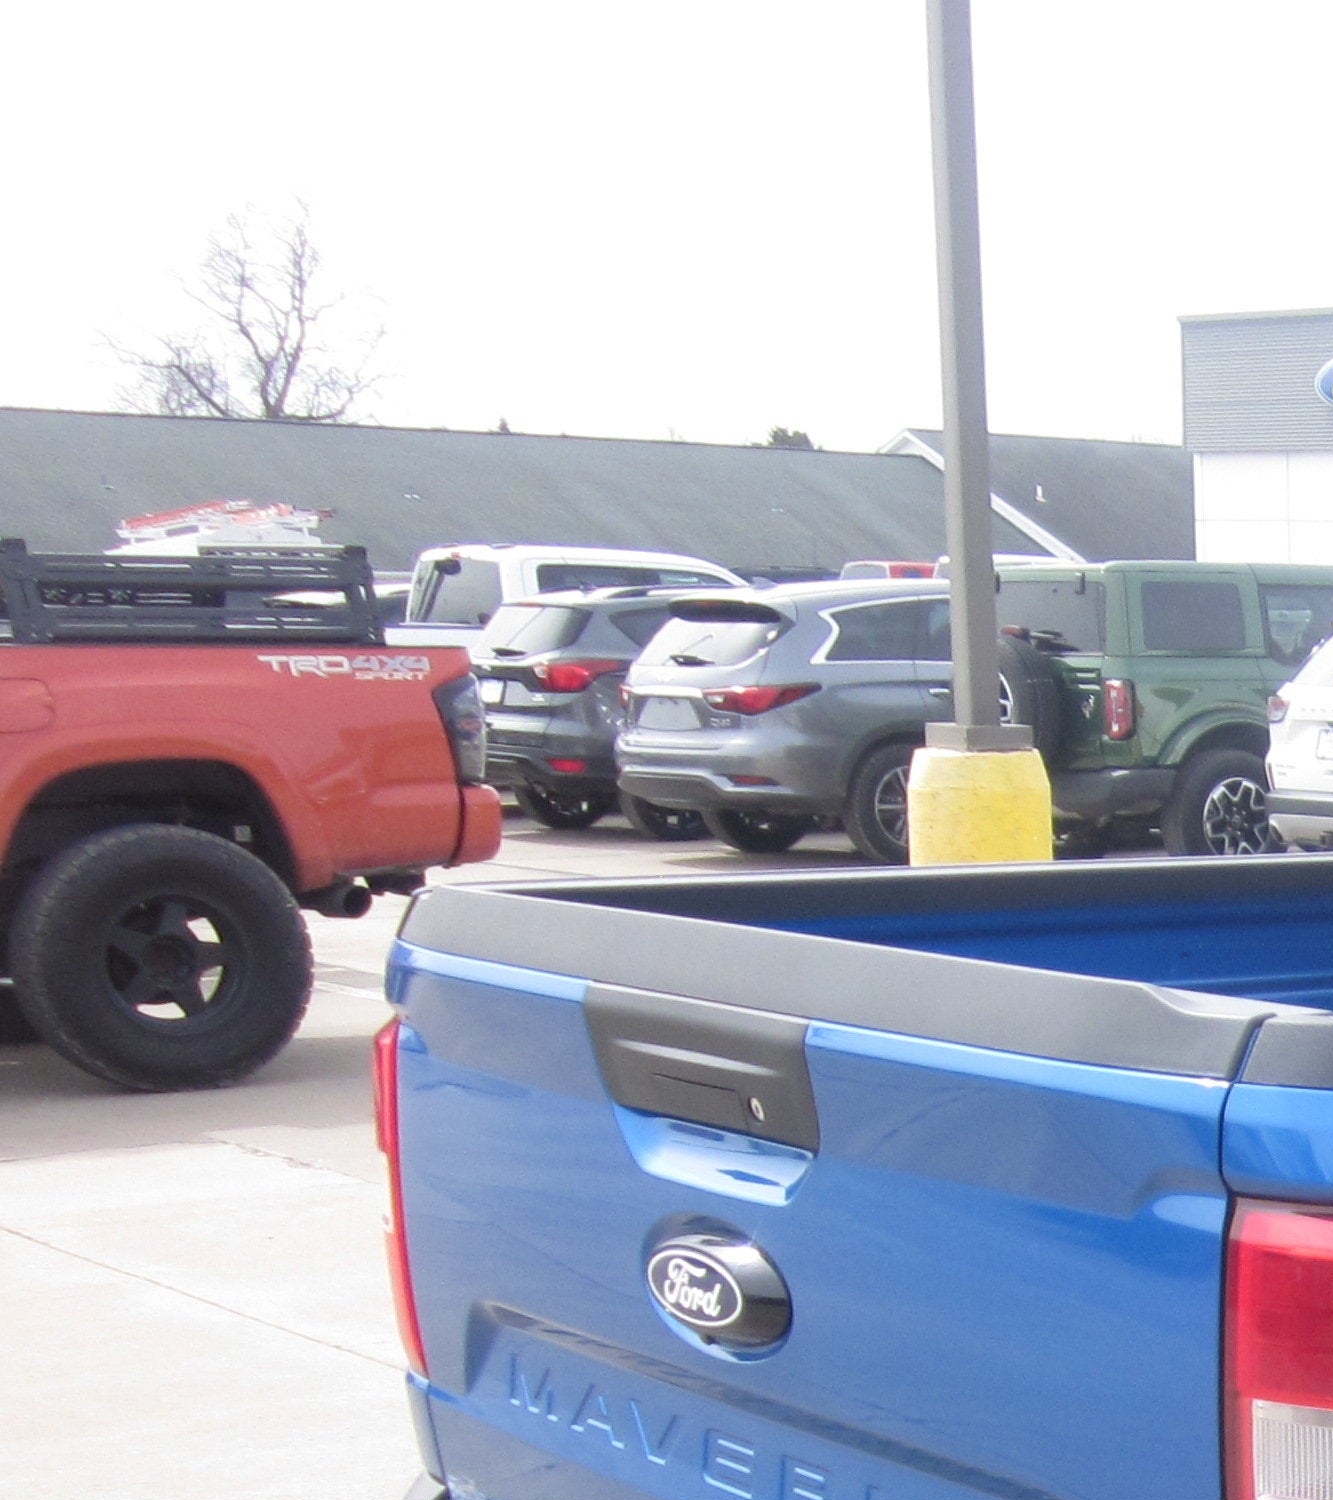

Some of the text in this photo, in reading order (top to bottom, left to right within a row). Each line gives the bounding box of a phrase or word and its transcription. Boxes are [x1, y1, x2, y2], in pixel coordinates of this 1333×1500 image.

[256, 654, 350, 678] TRD
[353, 671, 425, 681] SPORT
[663, 1257, 722, 1318] Ford
